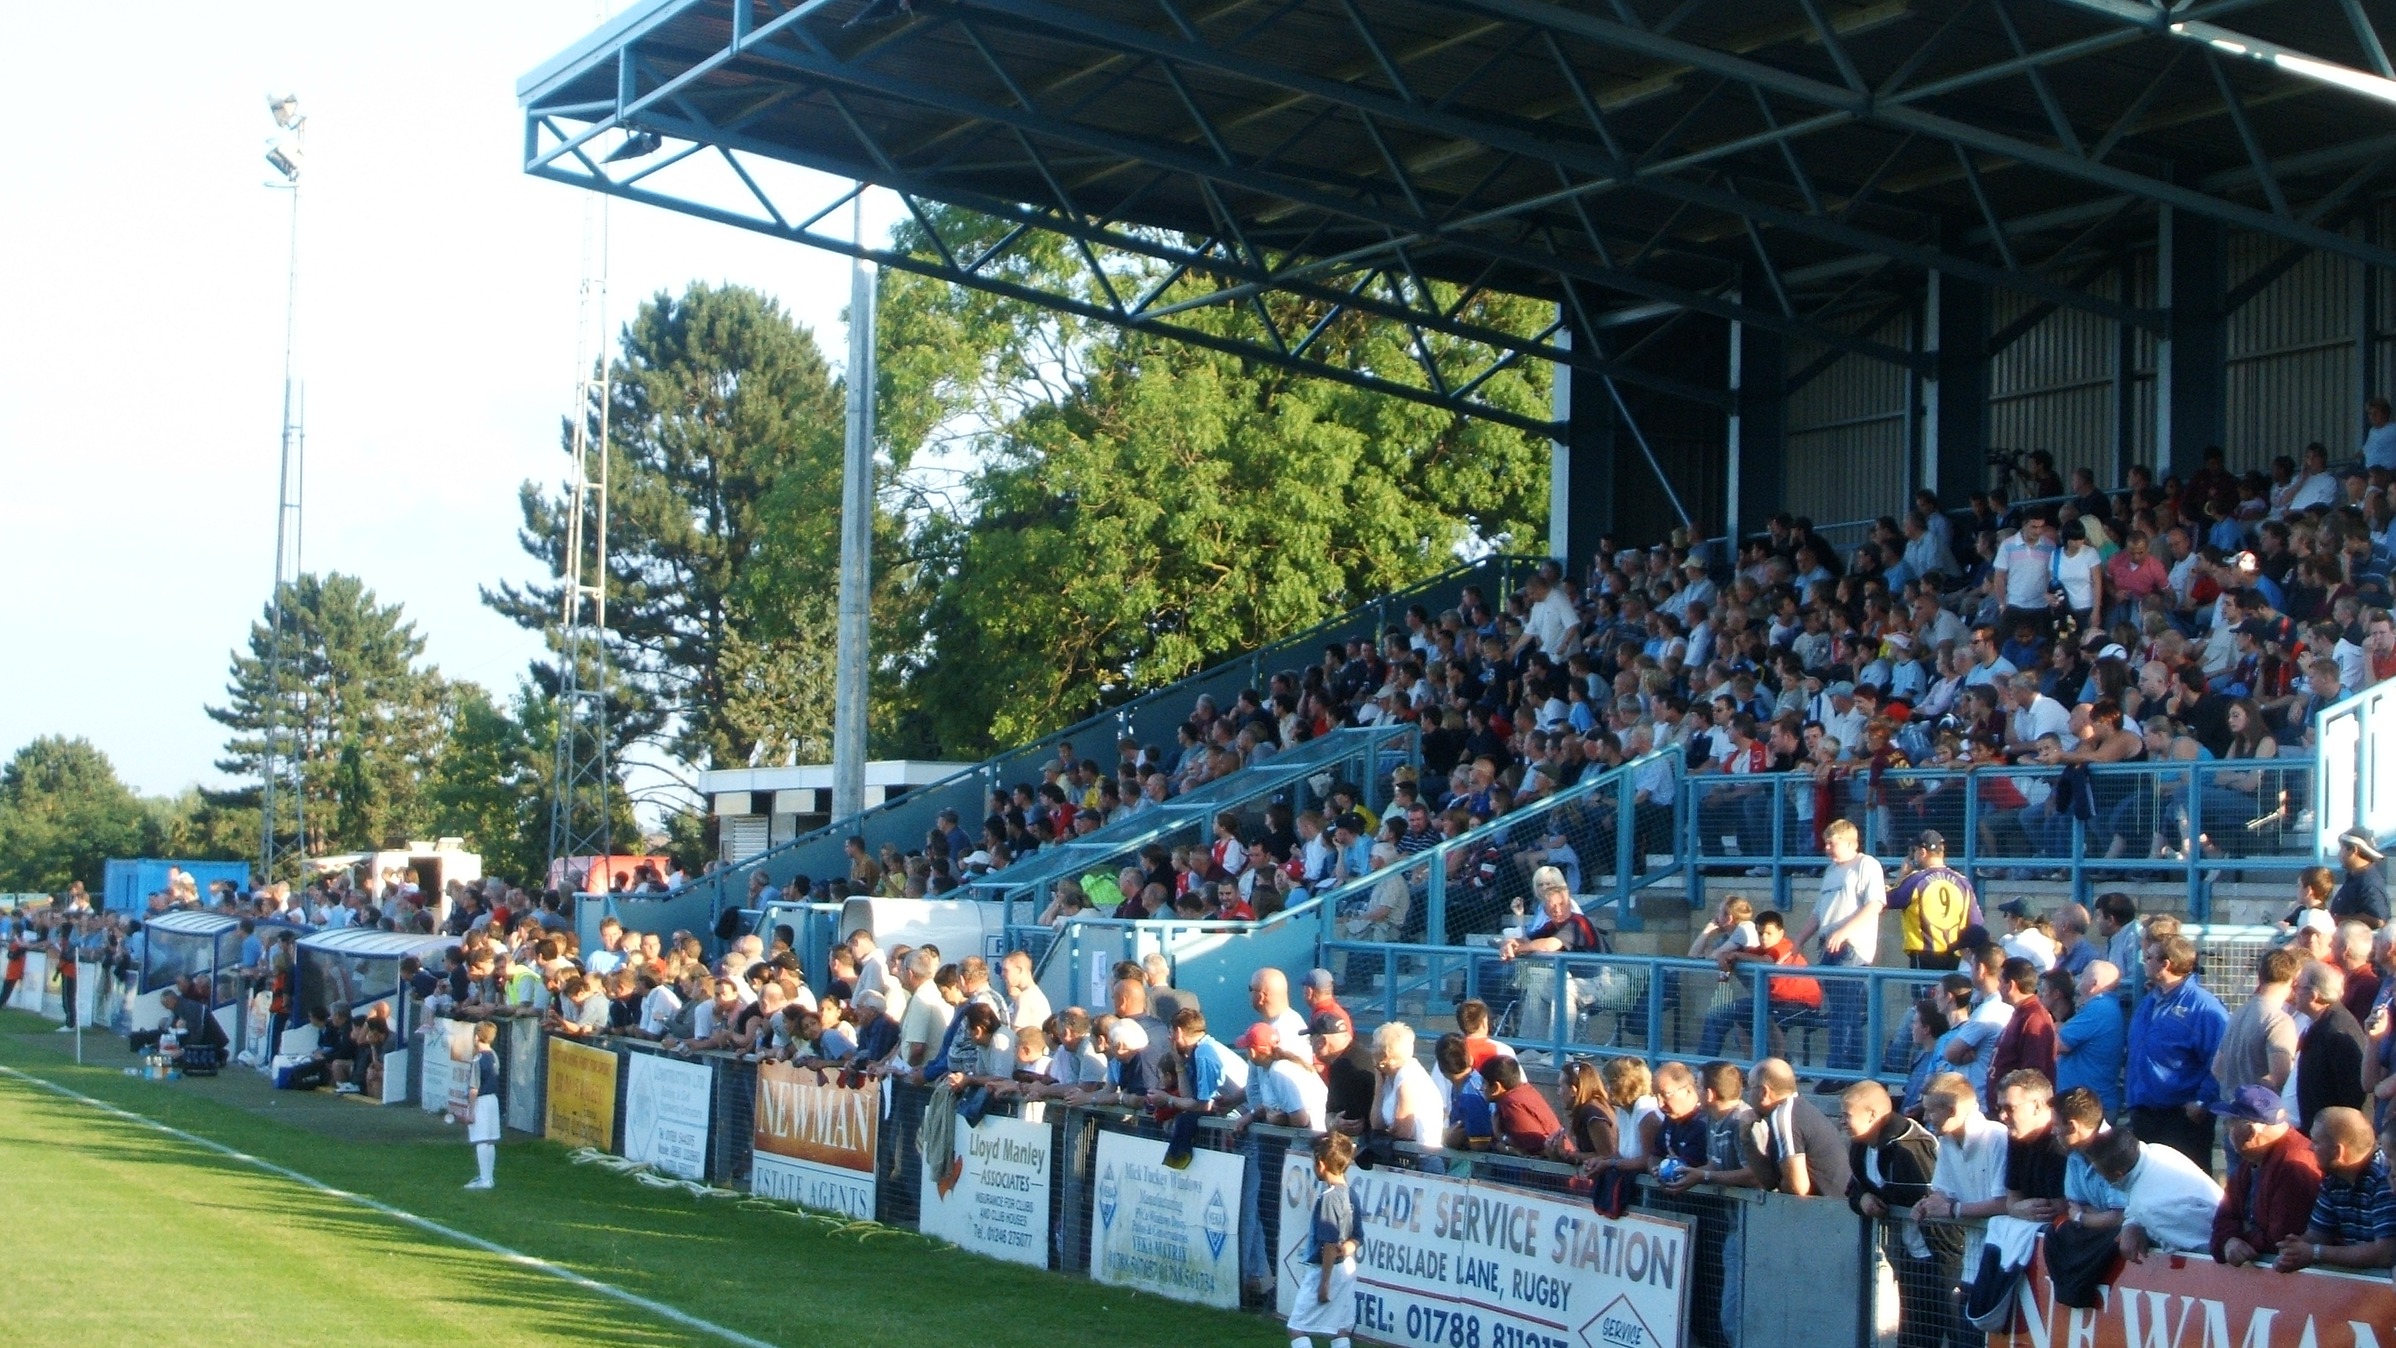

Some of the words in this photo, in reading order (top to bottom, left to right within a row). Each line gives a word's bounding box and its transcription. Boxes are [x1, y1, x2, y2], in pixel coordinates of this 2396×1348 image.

[1938, 886, 1951, 919] 9
[759, 1078, 872, 1153] NEWMAN
[969, 1132, 1001, 1166] Lloyd
[1003, 1138, 1046, 1175] Manley
[756, 1166, 803, 1202] ESTATE
[809, 1178, 868, 1217] AGENTS
[980, 1168, 1031, 1193] ASSOCIATES
[1004, 1196, 1016, 1210] FOR
[980, 1207, 990, 1220] AND
[991, 1210, 1005, 1223] CLUB
[1006, 1212, 1028, 1227] HOUSES
[1286, 1164, 1424, 1233] OVSLADE
[1433, 1191, 1540, 1258] SERVICE
[1551, 1214, 1677, 1290] STATION
[1355, 1237, 1448, 1282] OVERSLADE
[1455, 1255, 1504, 1301] LANE,
[1512, 1267, 1573, 1312] RUGBY
[1354, 1290, 1395, 1334] TEL:
[1406, 1303, 1481, 1348] 01788
[1493, 1322, 1569, 1348] 811
[1601, 1316, 1644, 1346] SERVICE
[2007, 1272, 2396, 1348] NEWM
